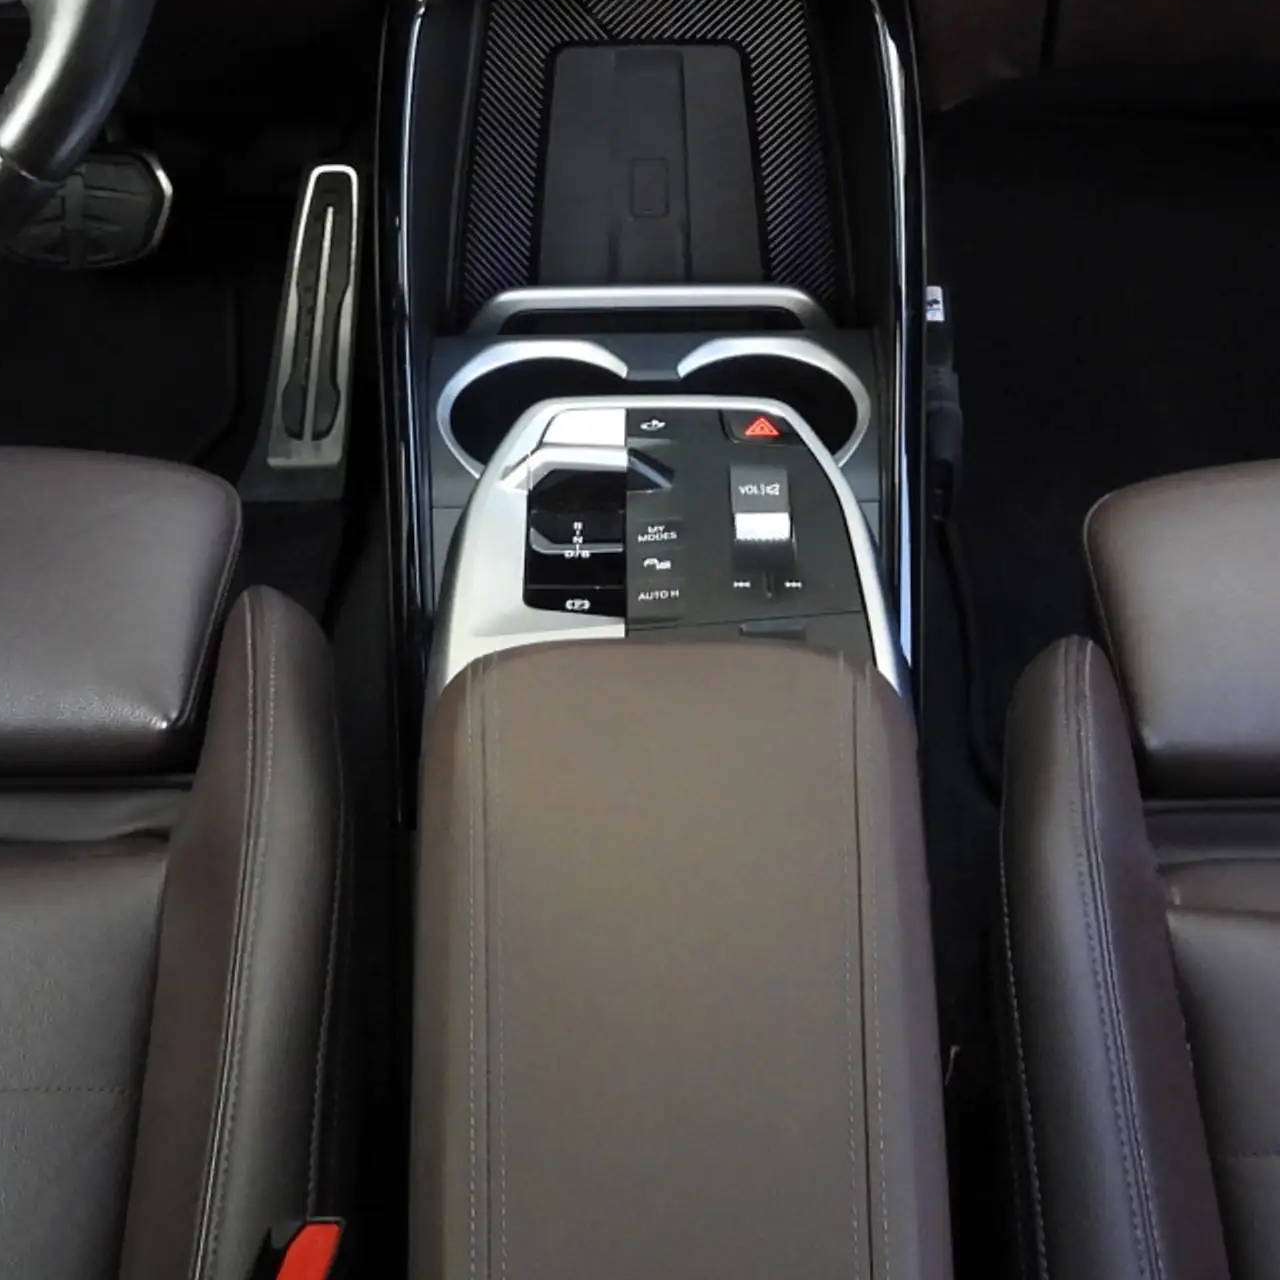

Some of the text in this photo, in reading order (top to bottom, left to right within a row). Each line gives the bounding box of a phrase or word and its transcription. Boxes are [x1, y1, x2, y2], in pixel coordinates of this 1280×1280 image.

[648, 525, 665, 534] MY
[637, 532, 677, 542] MODES
[638, 588, 680, 601] AUTO H
